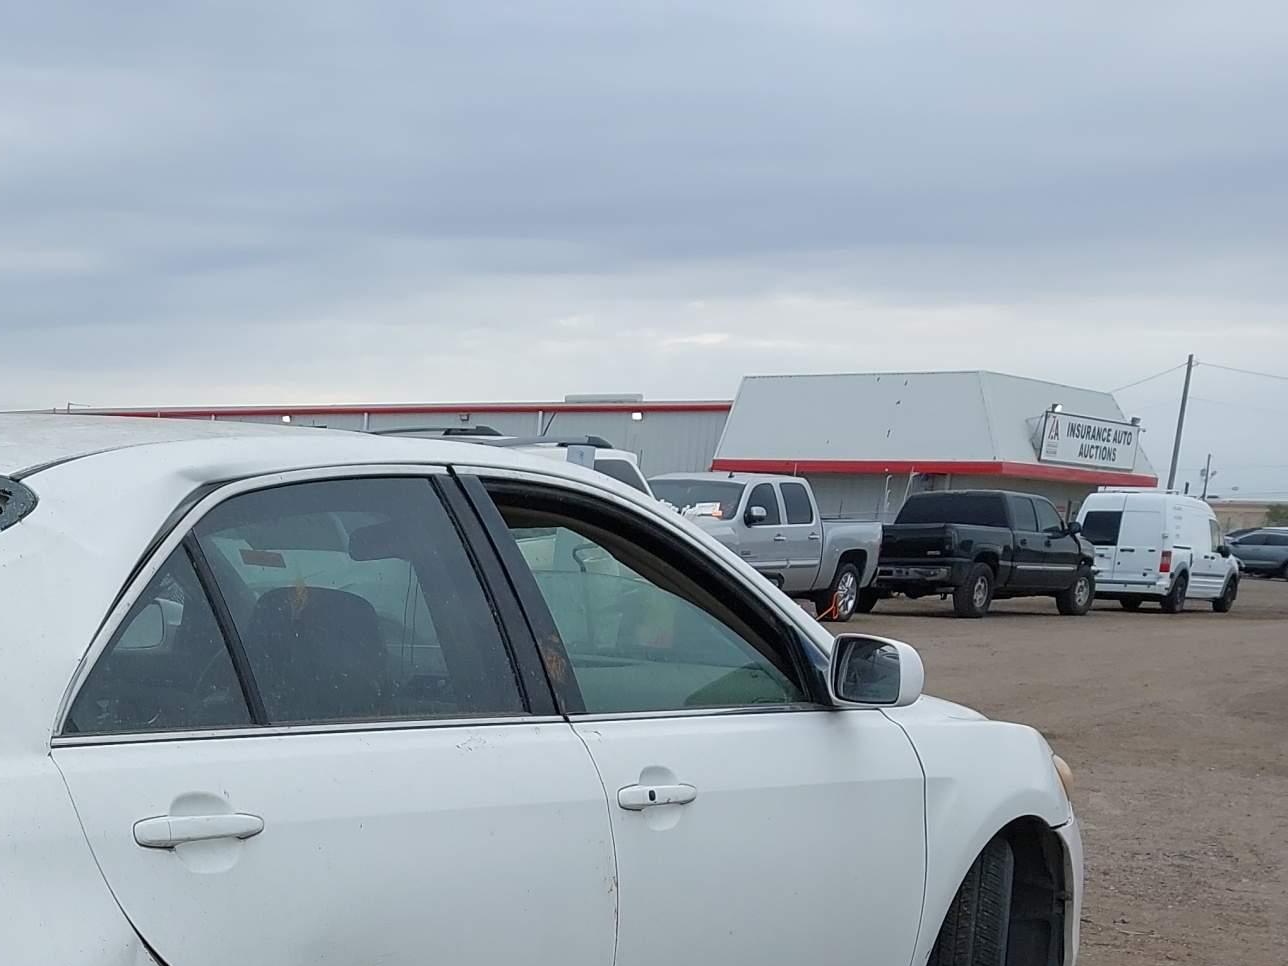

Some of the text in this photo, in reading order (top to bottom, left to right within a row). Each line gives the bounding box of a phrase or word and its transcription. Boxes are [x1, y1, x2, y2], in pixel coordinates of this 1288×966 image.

[1067, 422, 1133, 446] INSURANCE AUTO
[1078, 443, 1117, 462] AUCTIONS
